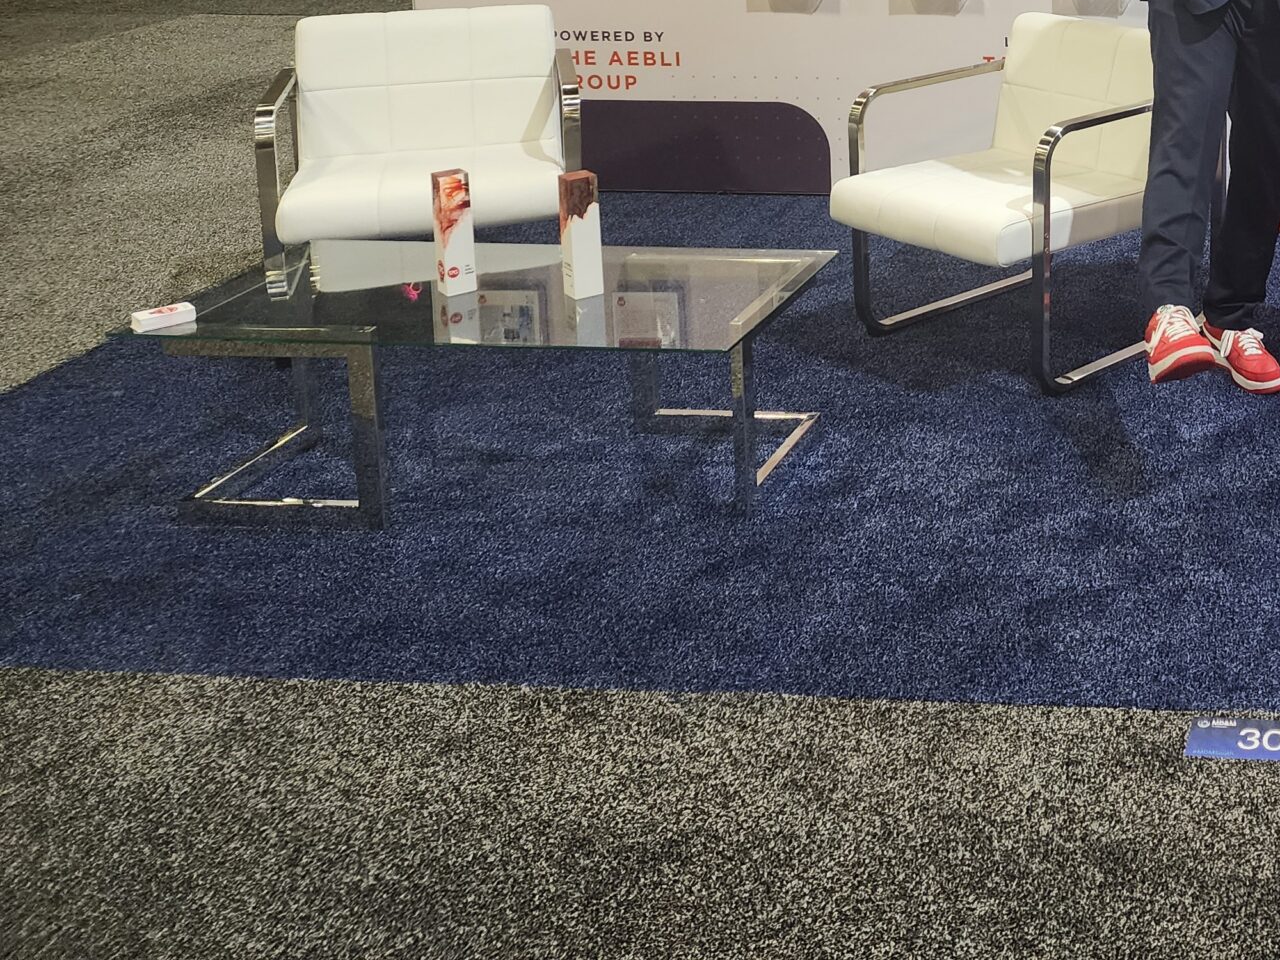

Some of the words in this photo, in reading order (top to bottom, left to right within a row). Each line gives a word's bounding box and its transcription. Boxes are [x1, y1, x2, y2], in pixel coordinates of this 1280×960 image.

[554, 30, 635, 42] OWERED
[643, 31, 664, 42] BY
[571, 50, 597, 66] HE
[608, 50, 681, 67] AEBLI
[575, 74, 638, 90] ROUP
